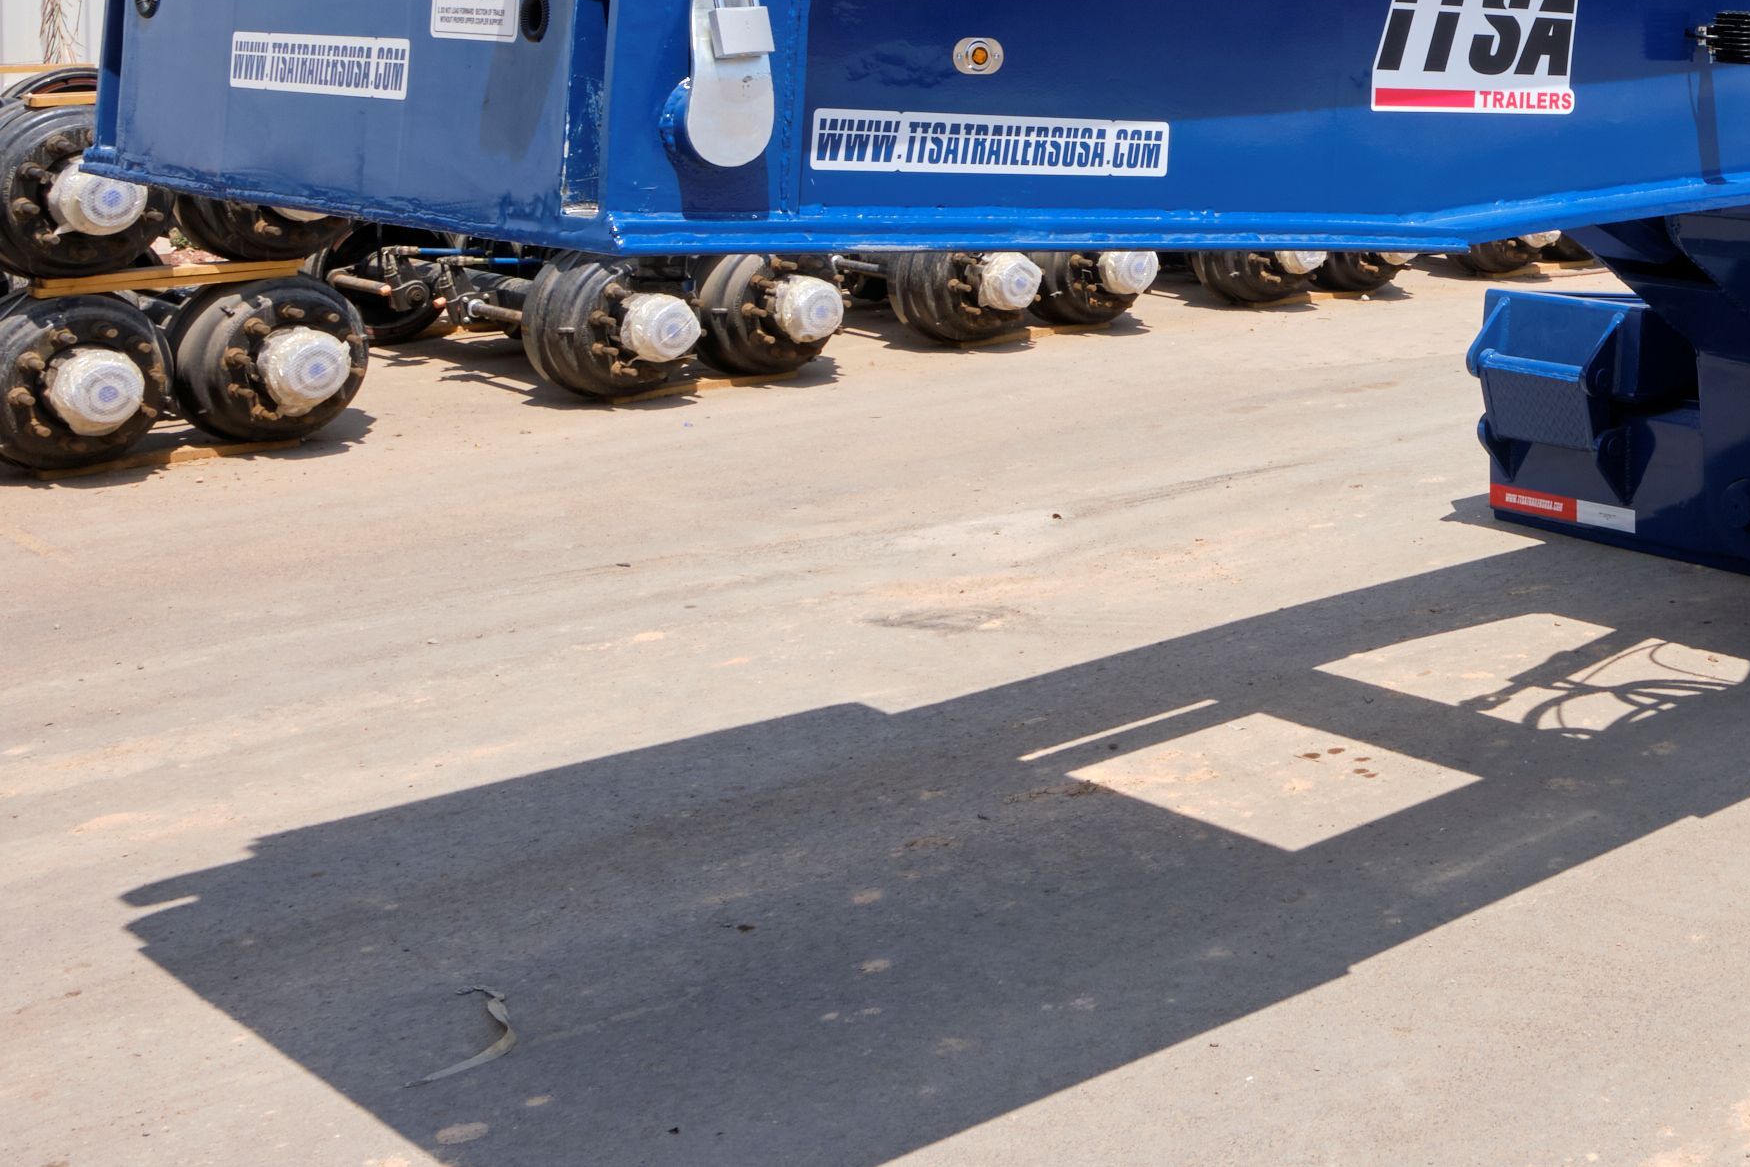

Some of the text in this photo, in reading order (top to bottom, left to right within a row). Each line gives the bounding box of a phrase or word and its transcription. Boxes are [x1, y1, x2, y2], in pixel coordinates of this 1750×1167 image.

[233, 40, 406, 91] WWW.TTSATRAILERSUSA.COM
[1480, 90, 1572, 110] TRAILERS
[816, 118, 1163, 169] WWW.TTSATRAILERSUSA.COM
